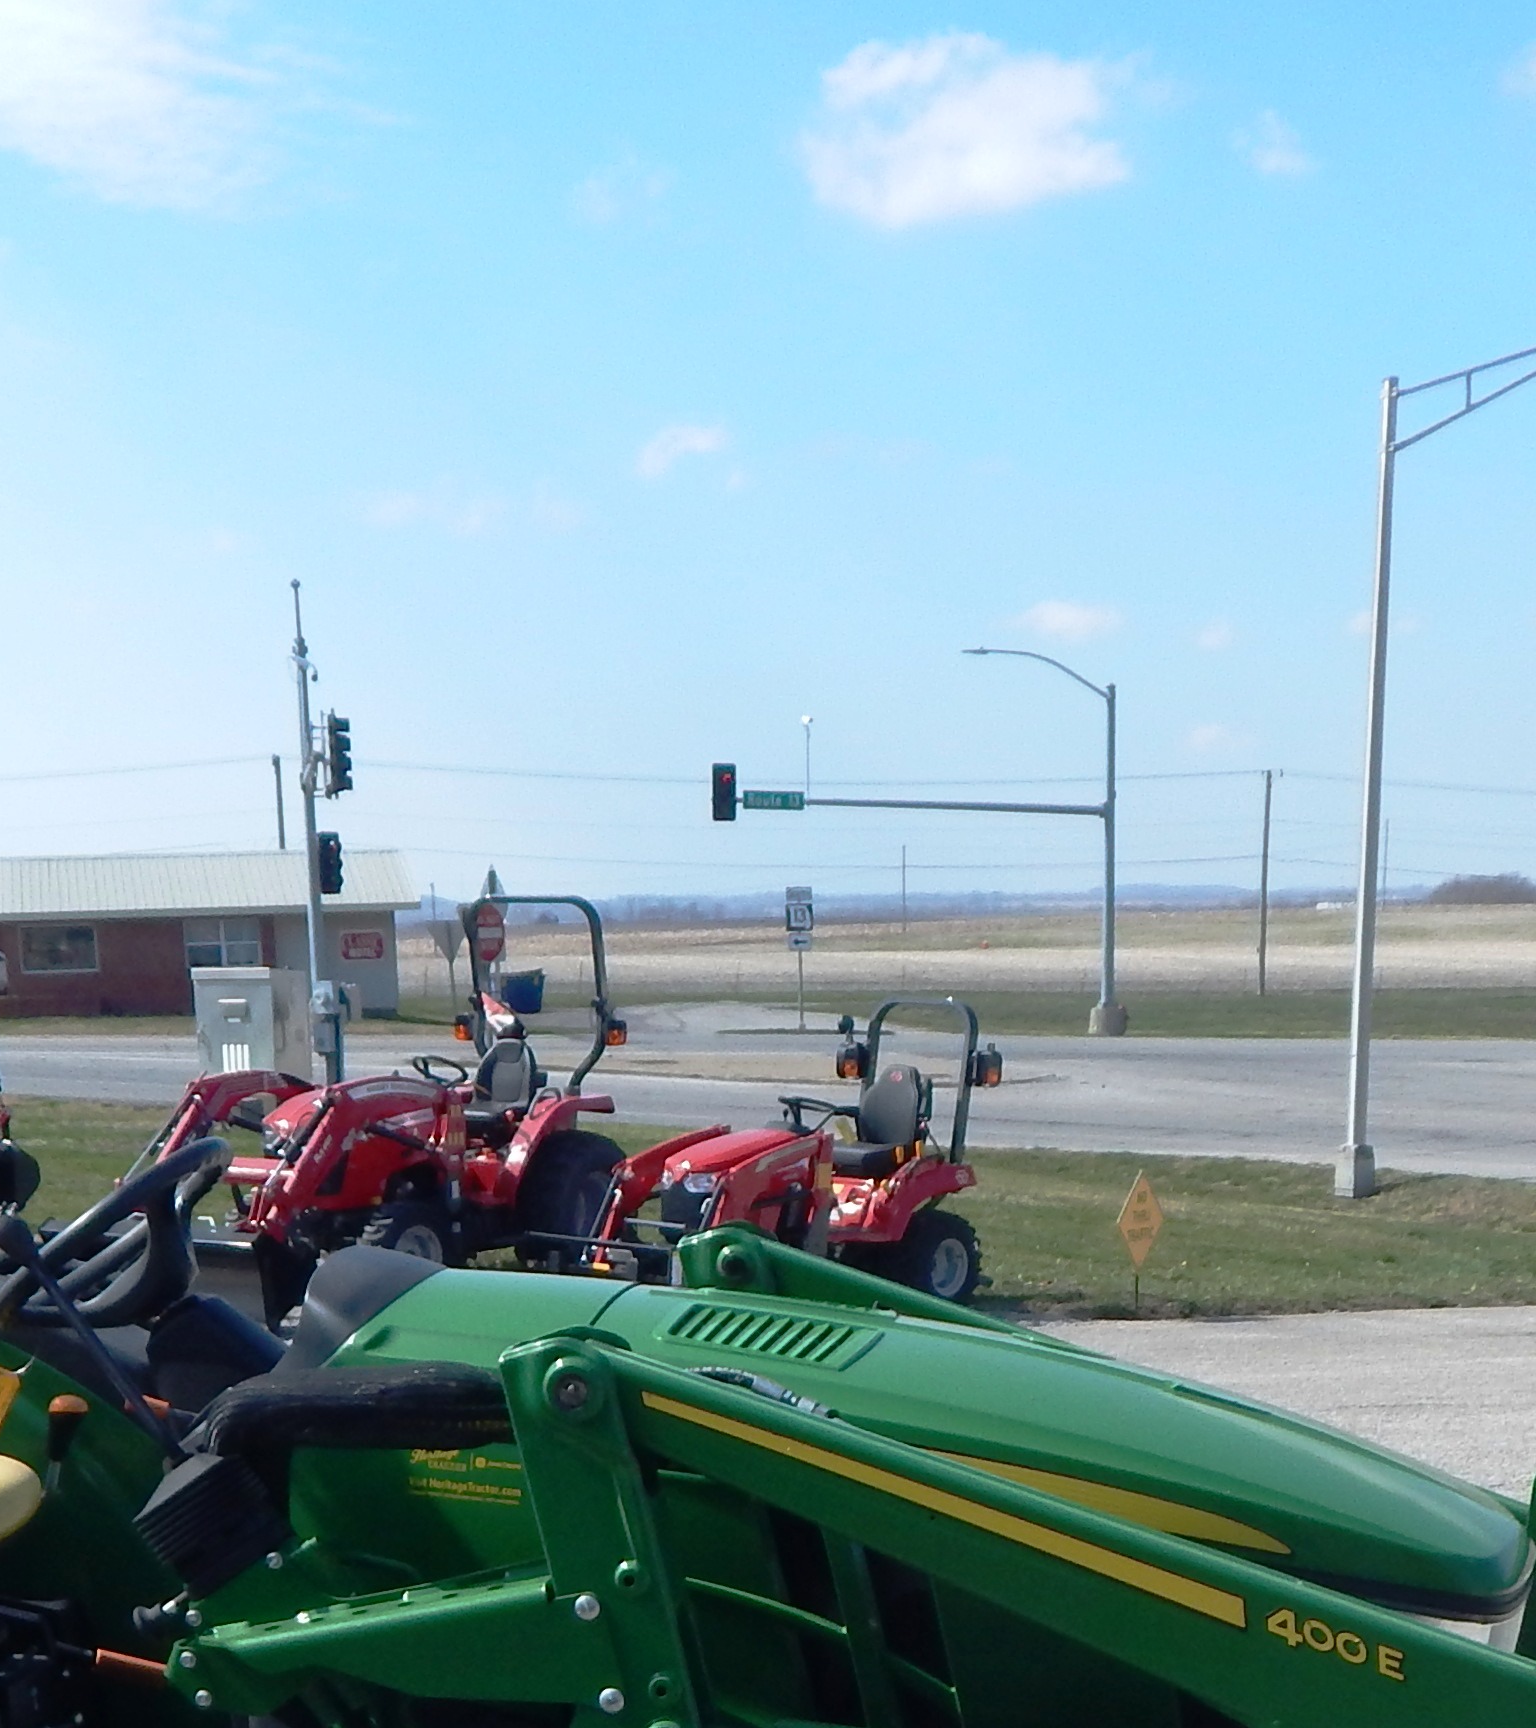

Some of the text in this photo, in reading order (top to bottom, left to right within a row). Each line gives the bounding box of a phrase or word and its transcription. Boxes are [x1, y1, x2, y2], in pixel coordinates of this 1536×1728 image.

[747, 792, 782, 808] Route
[794, 907, 806, 923] 13
[429, 1478, 521, 1496] HeritageTractor.com
[1266, 1608, 1405, 1681] 400 E
